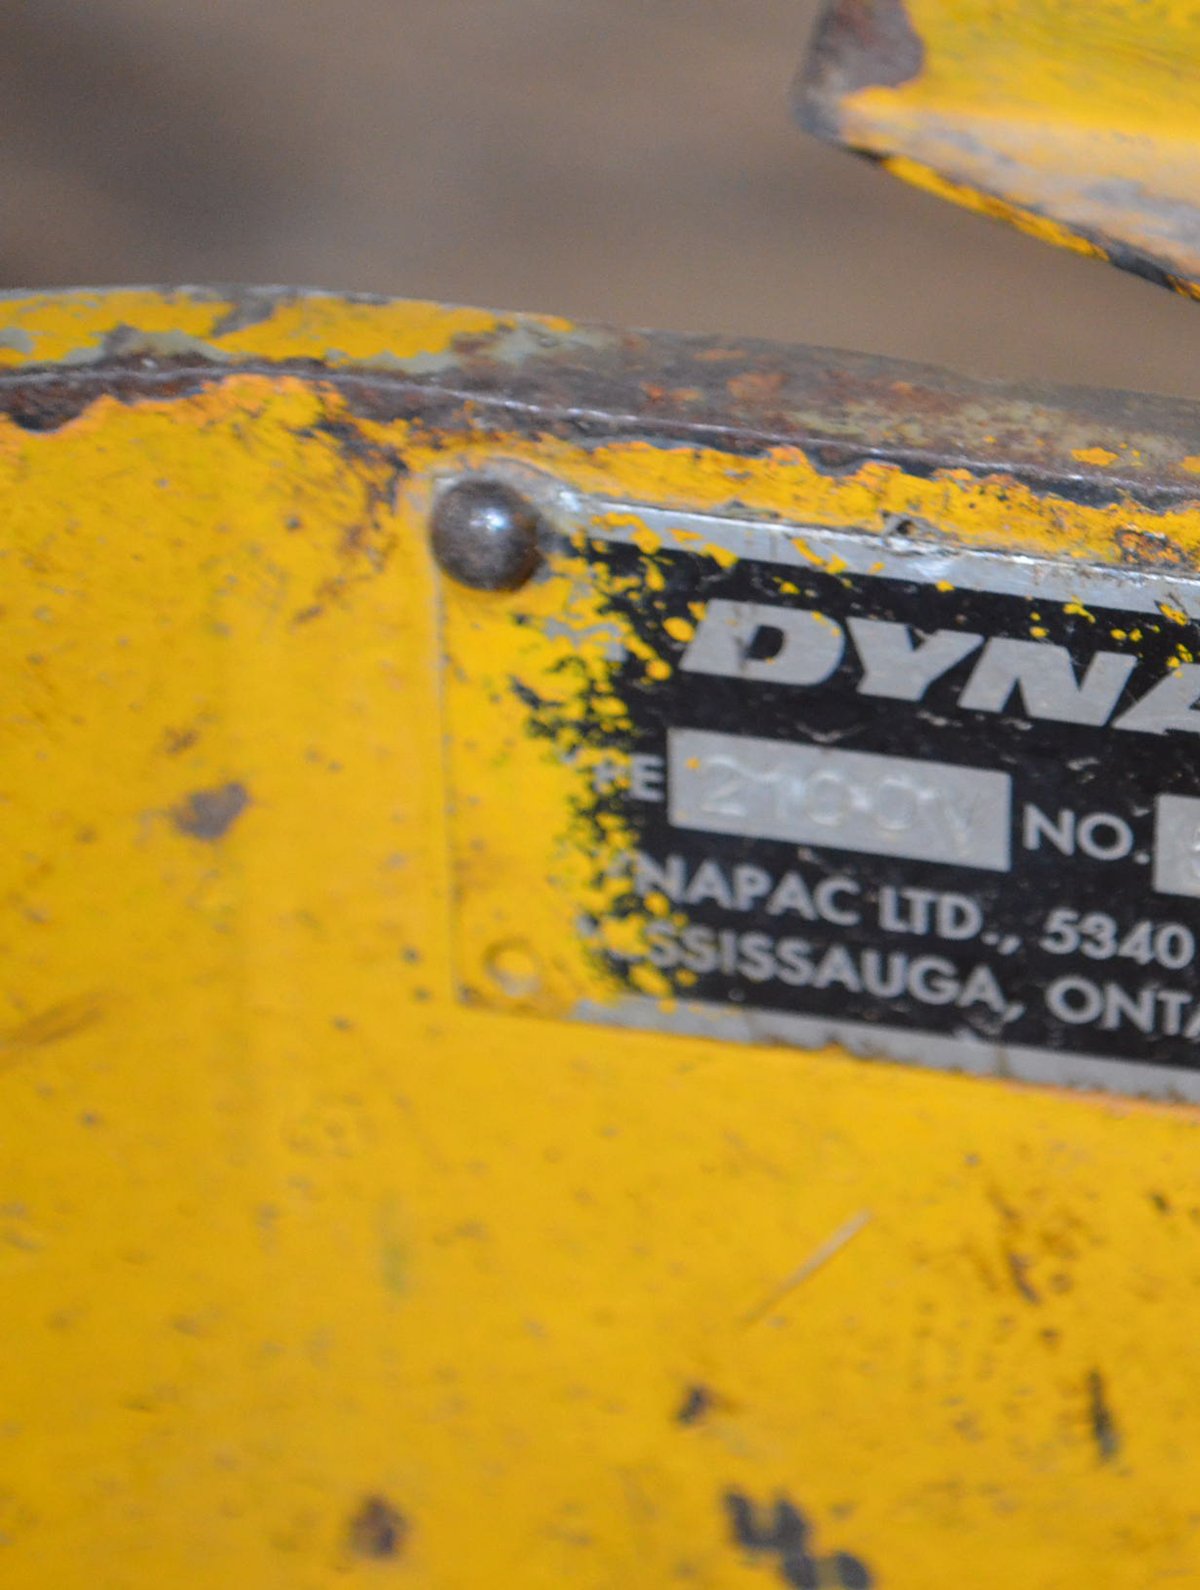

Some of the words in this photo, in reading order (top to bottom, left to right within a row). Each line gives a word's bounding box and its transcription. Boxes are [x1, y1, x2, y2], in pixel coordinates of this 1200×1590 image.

[1022, 808, 1152, 864] NO.
[878, 886, 1021, 956] LTD.,
[1041, 907, 1194, 970] 5340
